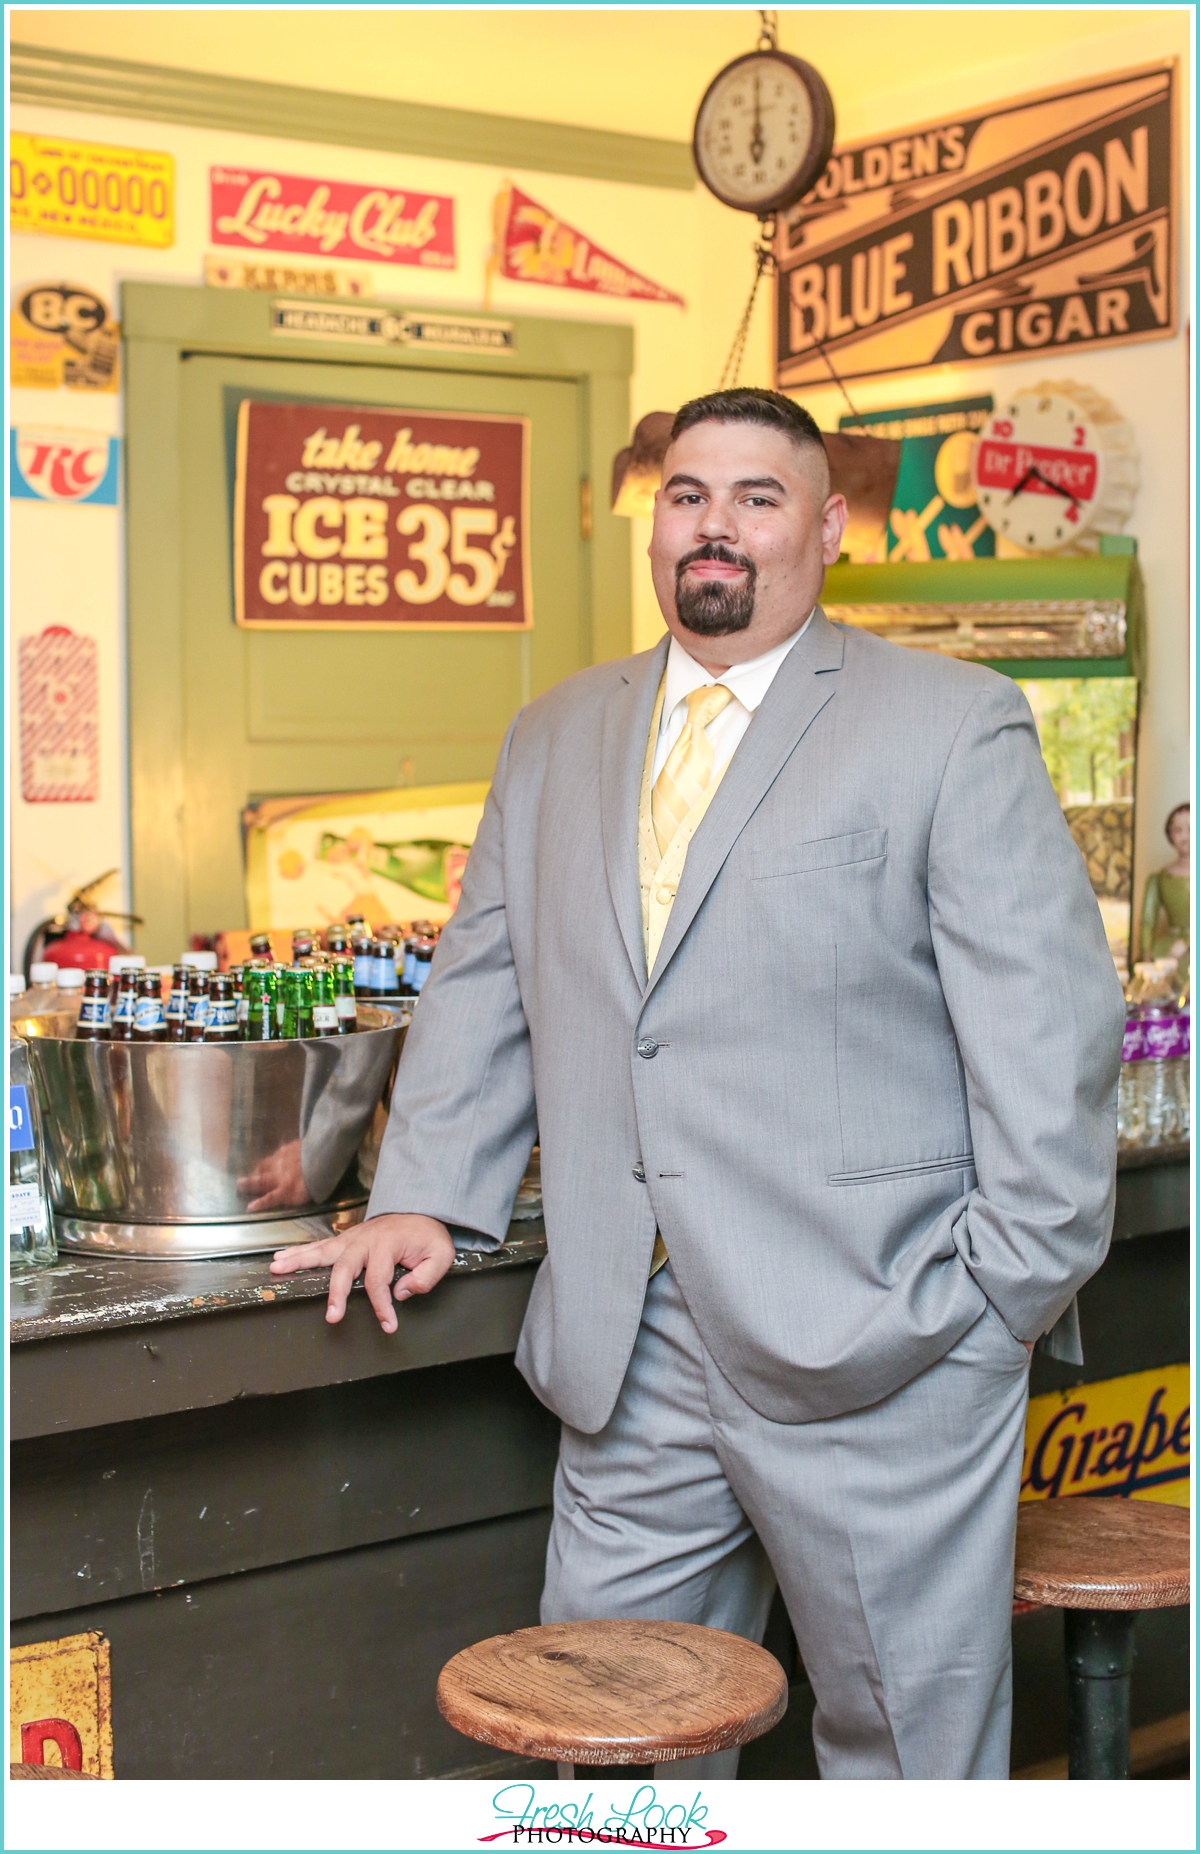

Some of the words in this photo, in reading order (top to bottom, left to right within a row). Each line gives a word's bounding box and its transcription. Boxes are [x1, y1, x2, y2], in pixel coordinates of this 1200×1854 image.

[803, 125, 966, 204] OLDEN'S
[216, 176, 350, 252] Lucky
[350, 190, 440, 257] Club
[789, 232, 914, 354] BLUE
[932, 125, 1149, 296] RIBBON
[29, 291, 99, 332] BC
[961, 288, 1131, 356] CIGAR
[302, 423, 383, 472] take
[384, 427, 481, 478] home
[992, 419, 1014, 439] 10
[1073, 426, 1086, 447] 2
[26, 444, 104, 497] RC
[285, 471, 400, 497] CRYSTAL
[405, 477, 495, 502] CLEAR
[983, 448, 1013, 475] Dr
[262, 493, 389, 560] ICE
[259, 560, 389, 606] CUBES
